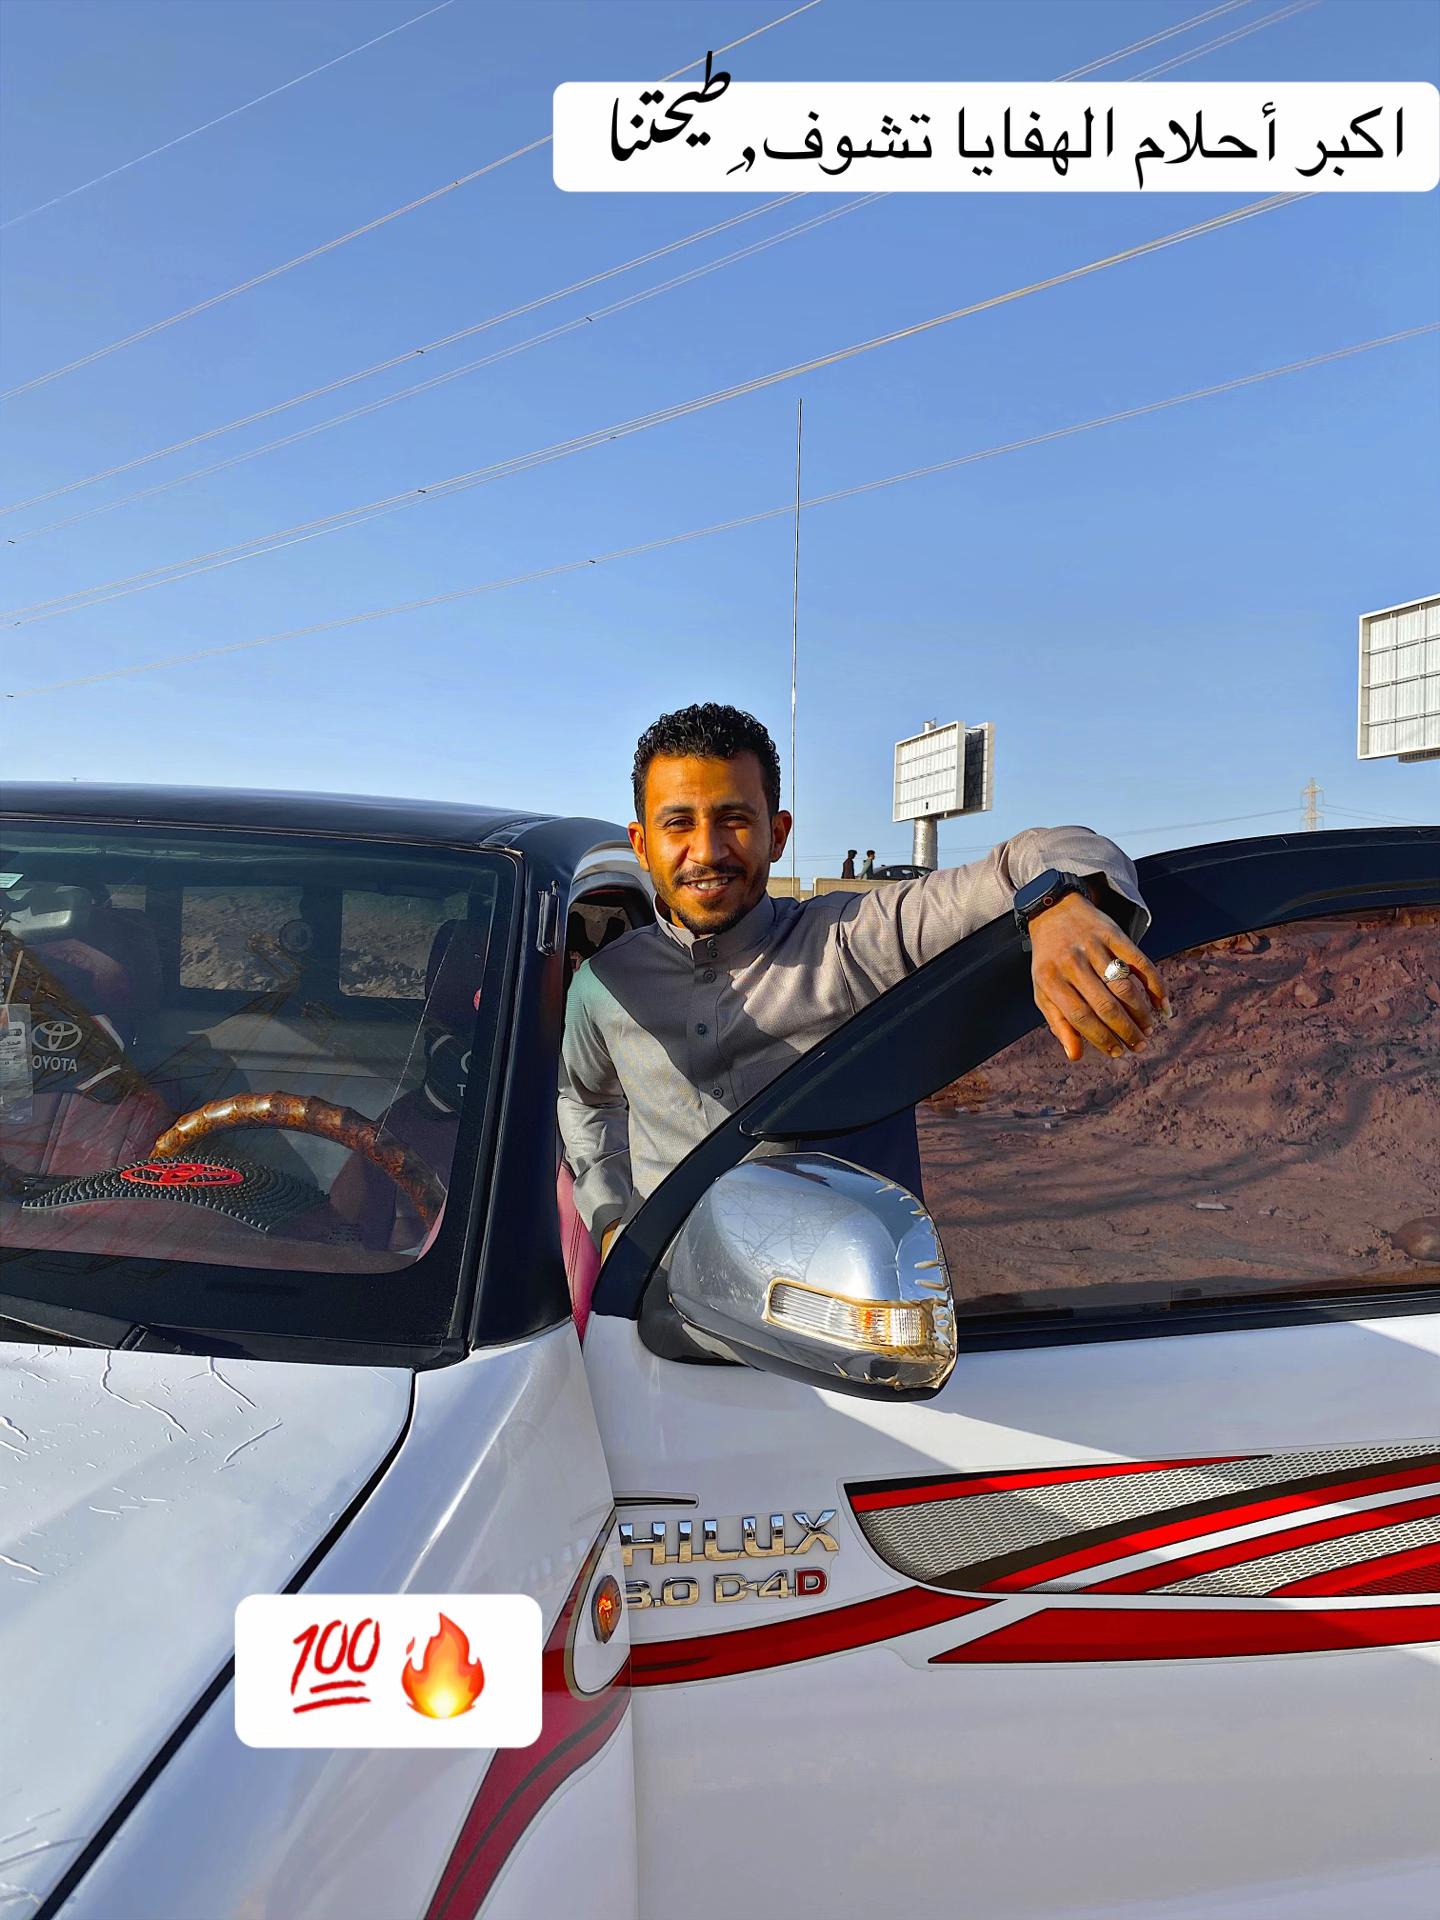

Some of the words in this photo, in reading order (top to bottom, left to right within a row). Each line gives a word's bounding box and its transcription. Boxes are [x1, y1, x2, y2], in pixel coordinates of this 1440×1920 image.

[31, 1054, 78, 1073] OYOTA
[618, 1508, 840, 1566] HILUX
[624, 1575, 700, 1611] 3.0
[713, 1565, 829, 1604] D-4D
